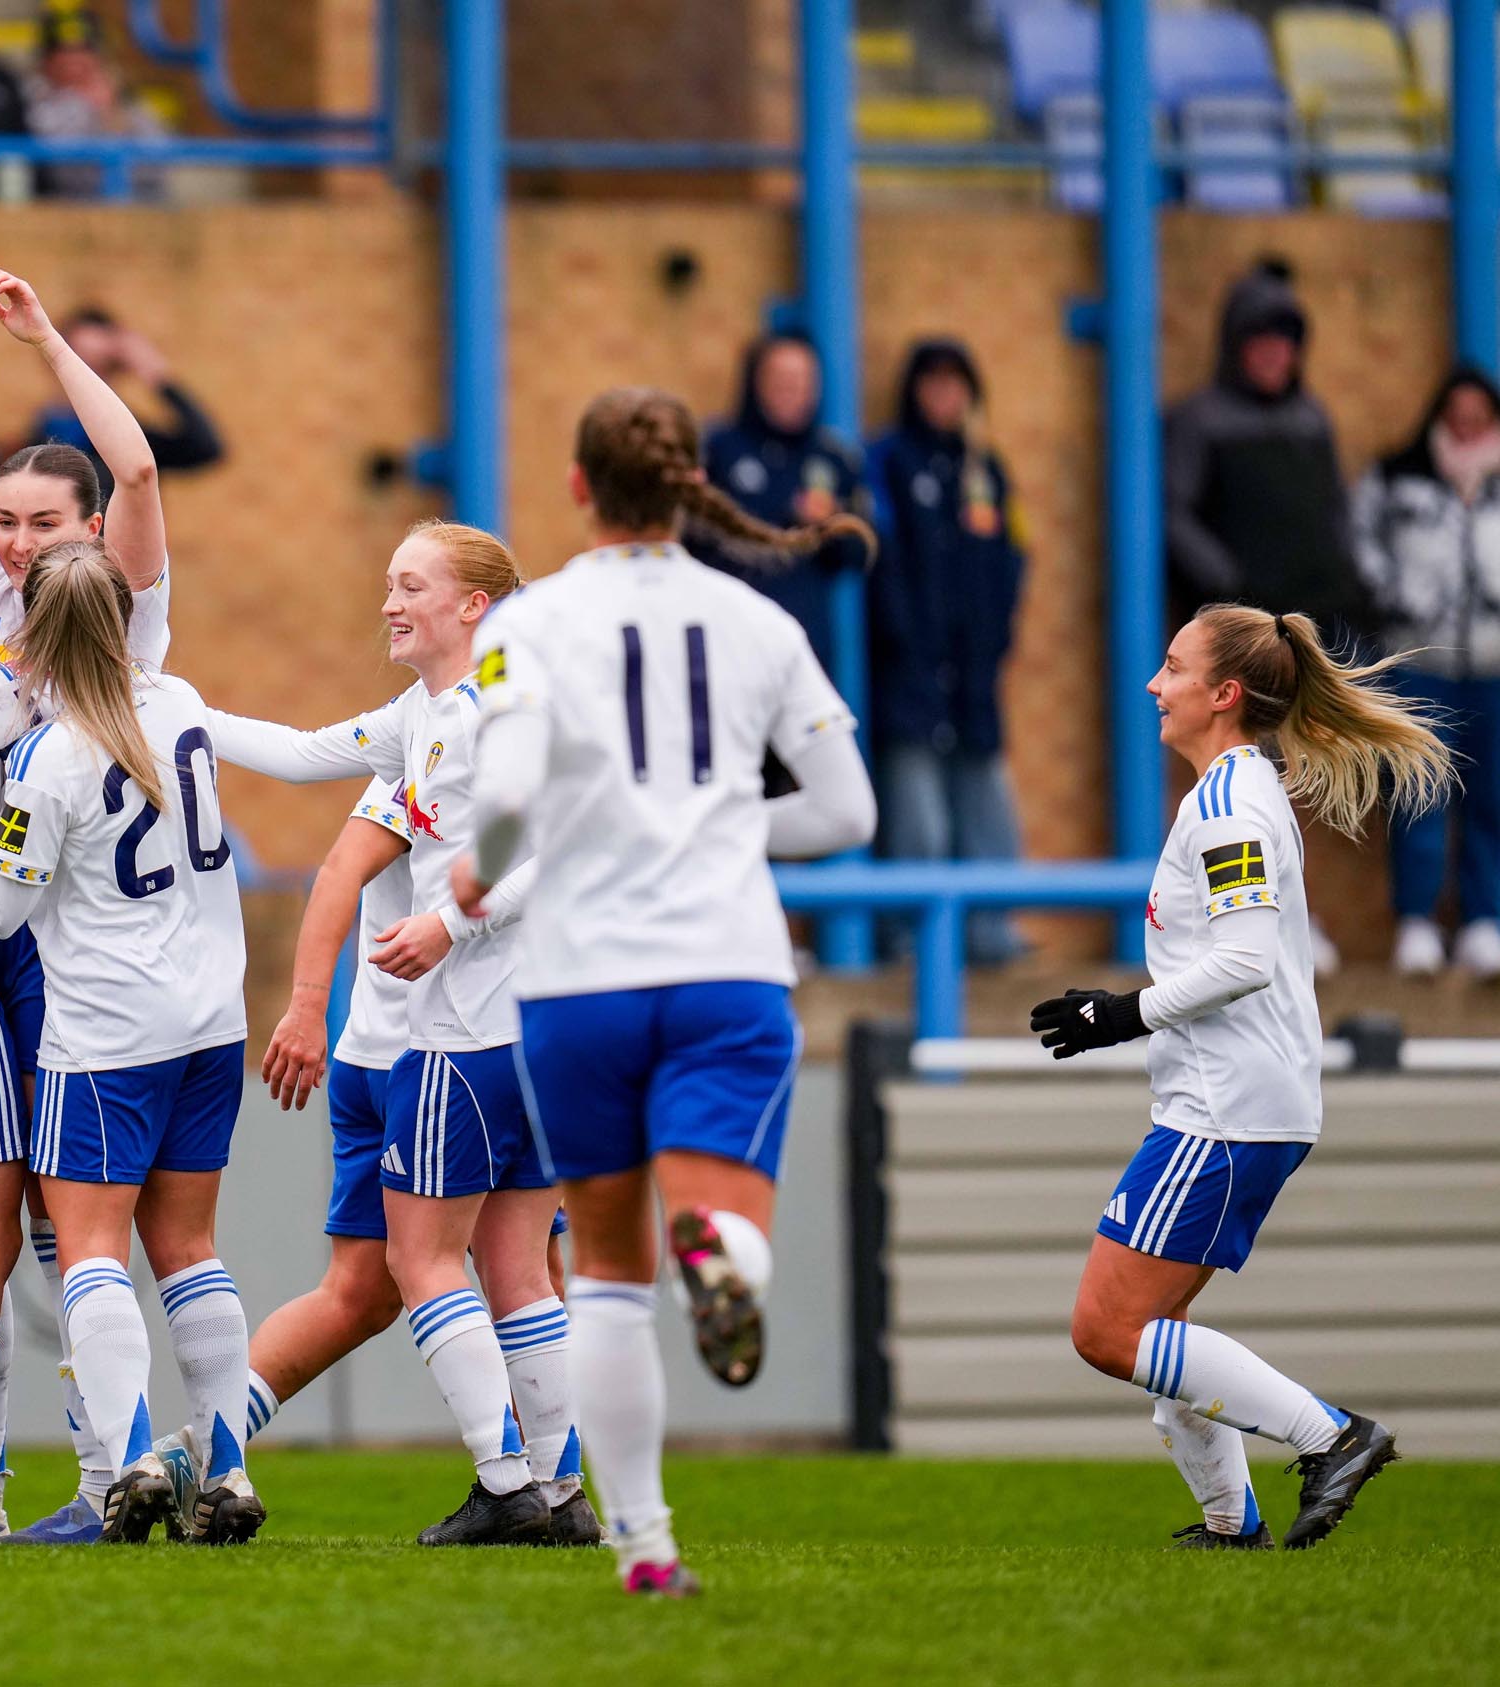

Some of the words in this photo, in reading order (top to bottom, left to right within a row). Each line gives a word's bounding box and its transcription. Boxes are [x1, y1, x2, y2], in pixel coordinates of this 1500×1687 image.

[622, 625, 712, 785] 11
[103, 727, 231, 899] 20
[1210, 876, 1266, 894] PARIMATCH
